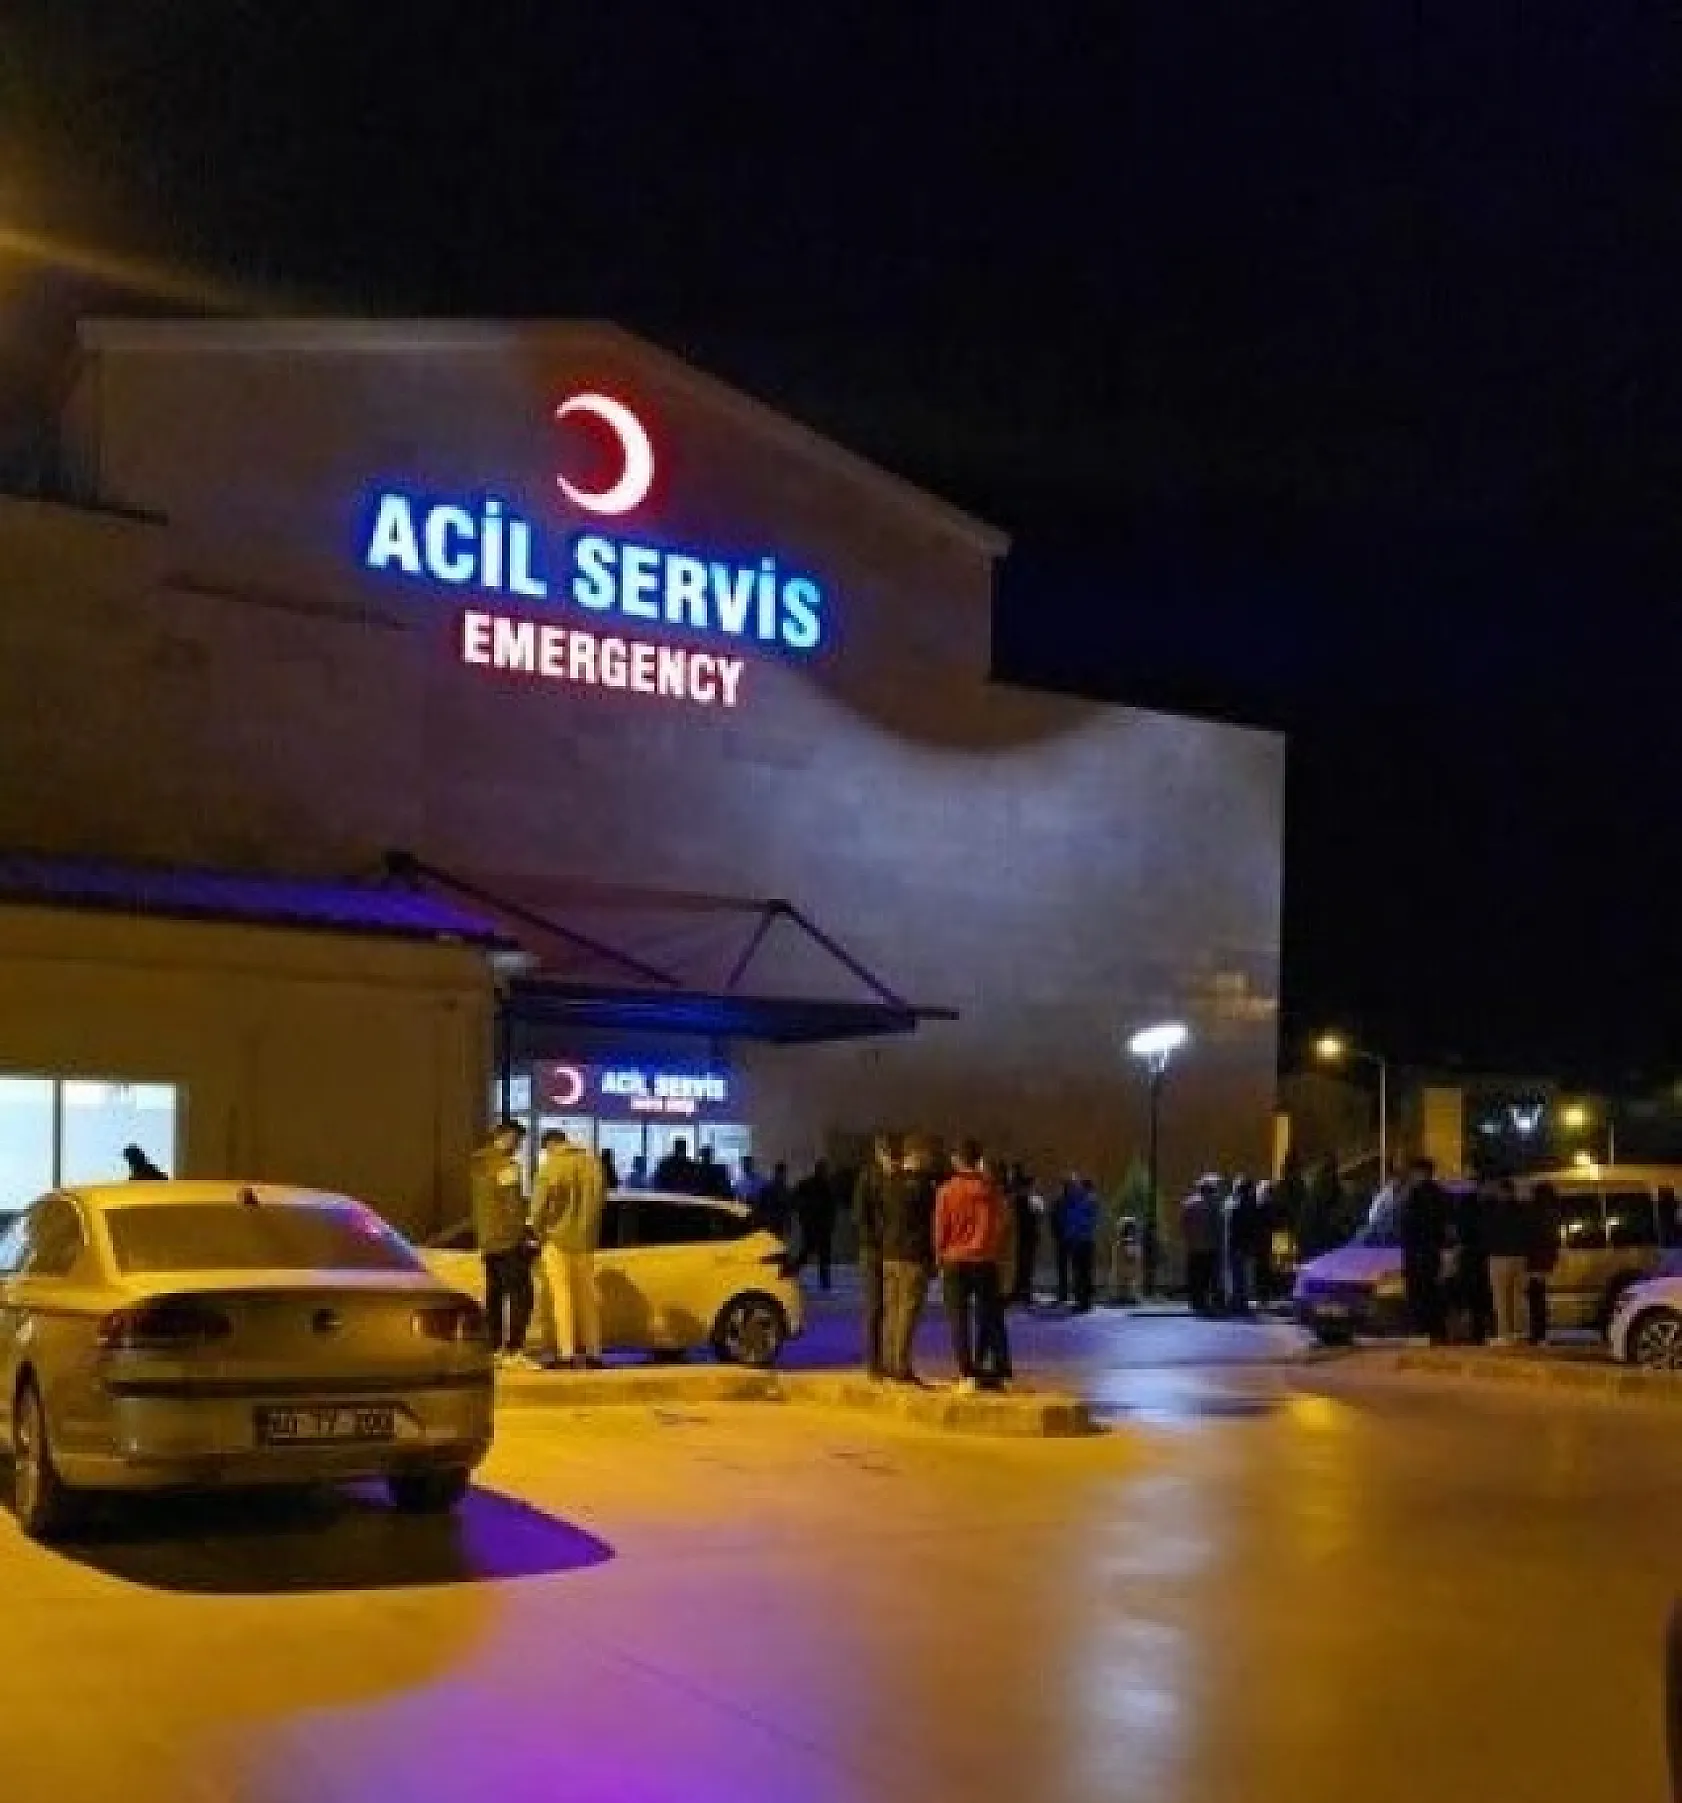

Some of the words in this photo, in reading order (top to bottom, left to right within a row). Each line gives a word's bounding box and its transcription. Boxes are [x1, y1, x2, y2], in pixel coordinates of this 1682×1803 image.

[367, 493, 548, 597] ACİL
[572, 536, 822, 648] SERVİS
[464, 610, 744, 707] EMERGENCY
